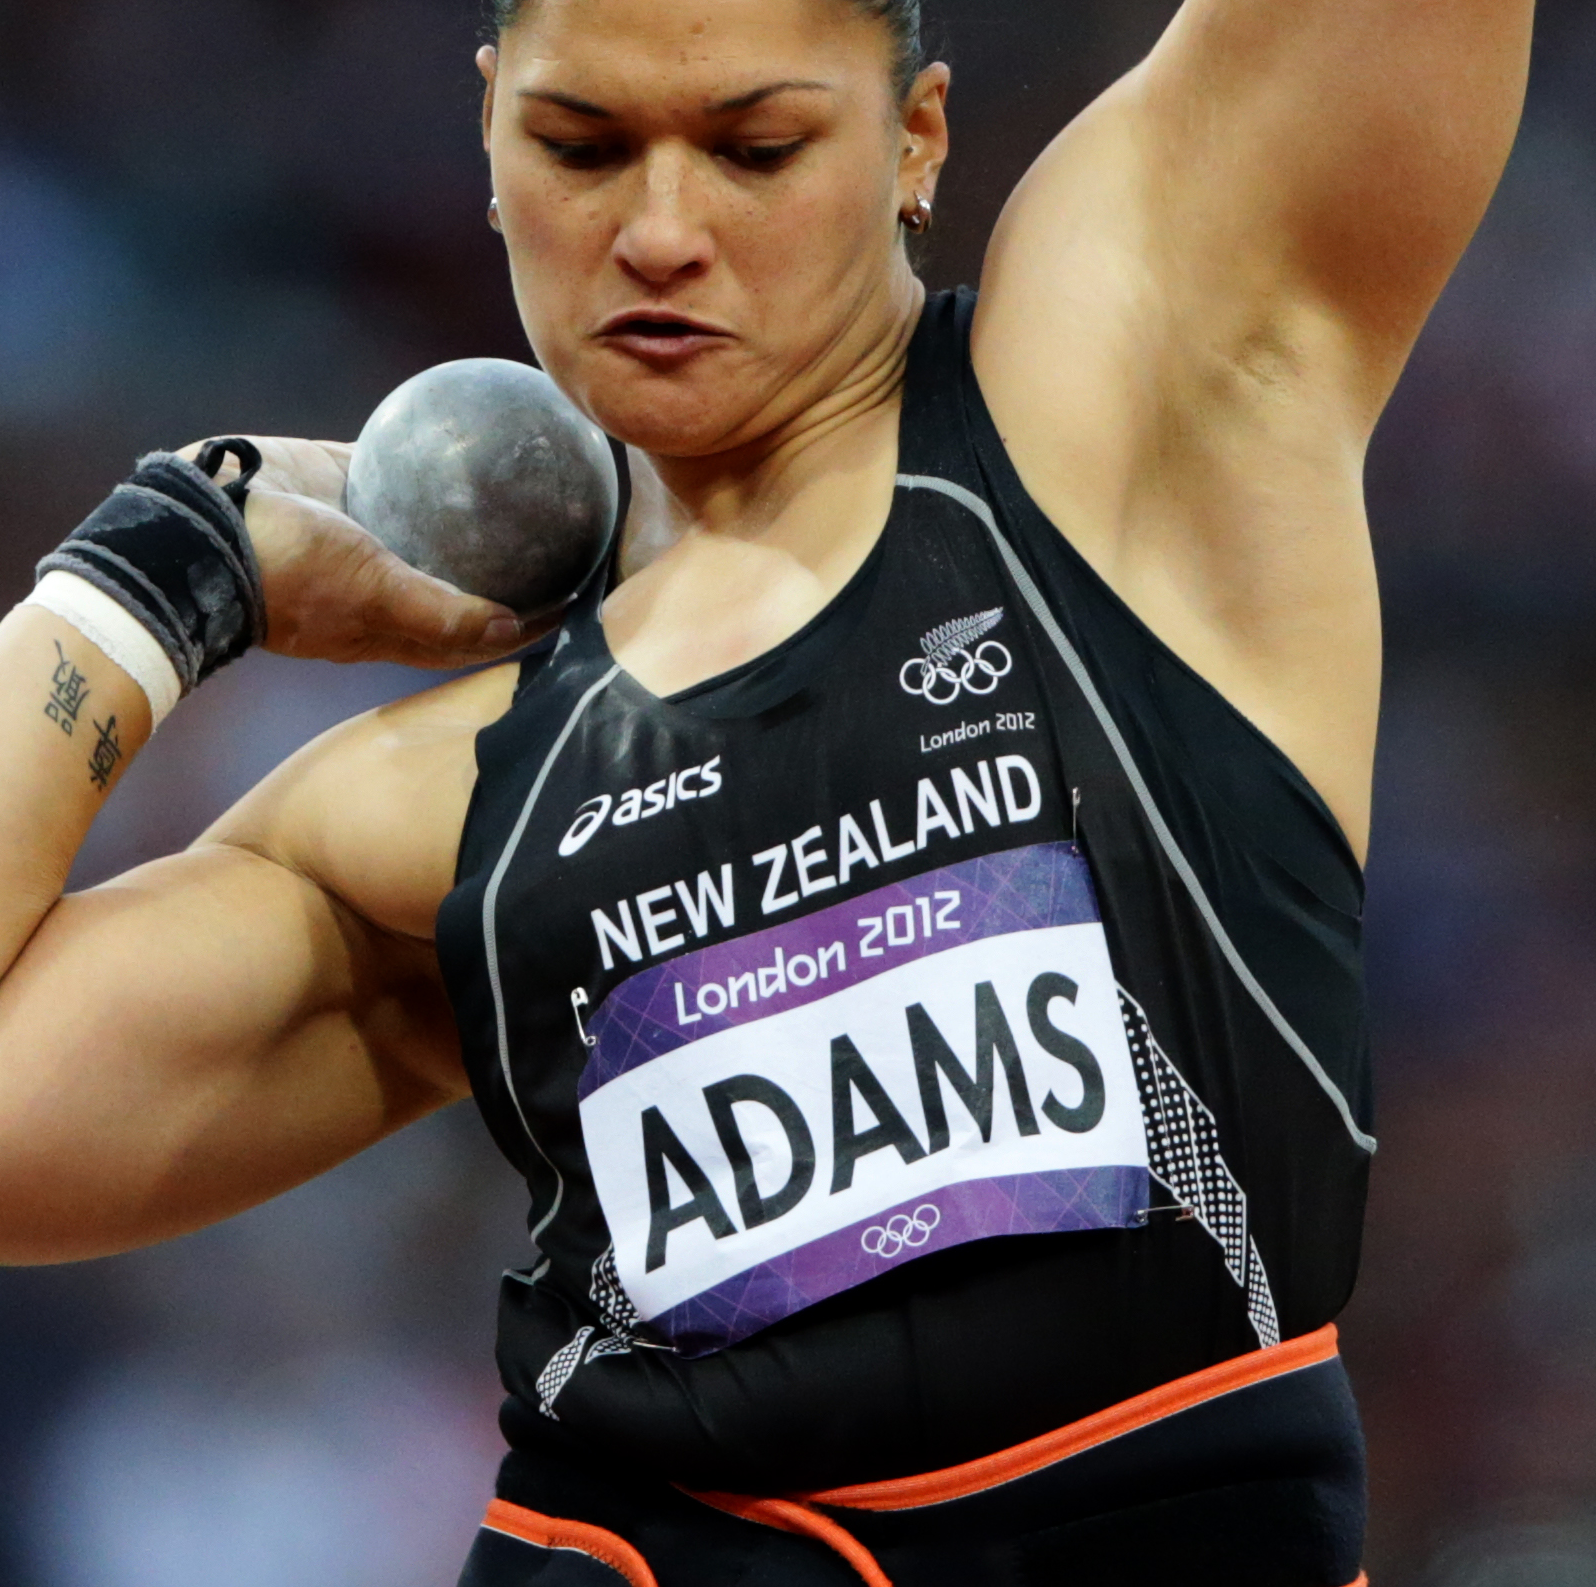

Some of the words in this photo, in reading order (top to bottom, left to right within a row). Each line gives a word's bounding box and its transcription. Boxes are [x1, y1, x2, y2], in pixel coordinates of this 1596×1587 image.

[611, 754, 722, 826] asics
[919, 720, 991, 753] London
[996, 712, 1036, 731] 2012
[591, 863, 735, 970] NEW
[752, 754, 1042, 915] ZEALAND
[675, 942, 846, 1026] London
[858, 890, 961, 958] 2012
[640, 971, 1105, 1274] ADAMS
